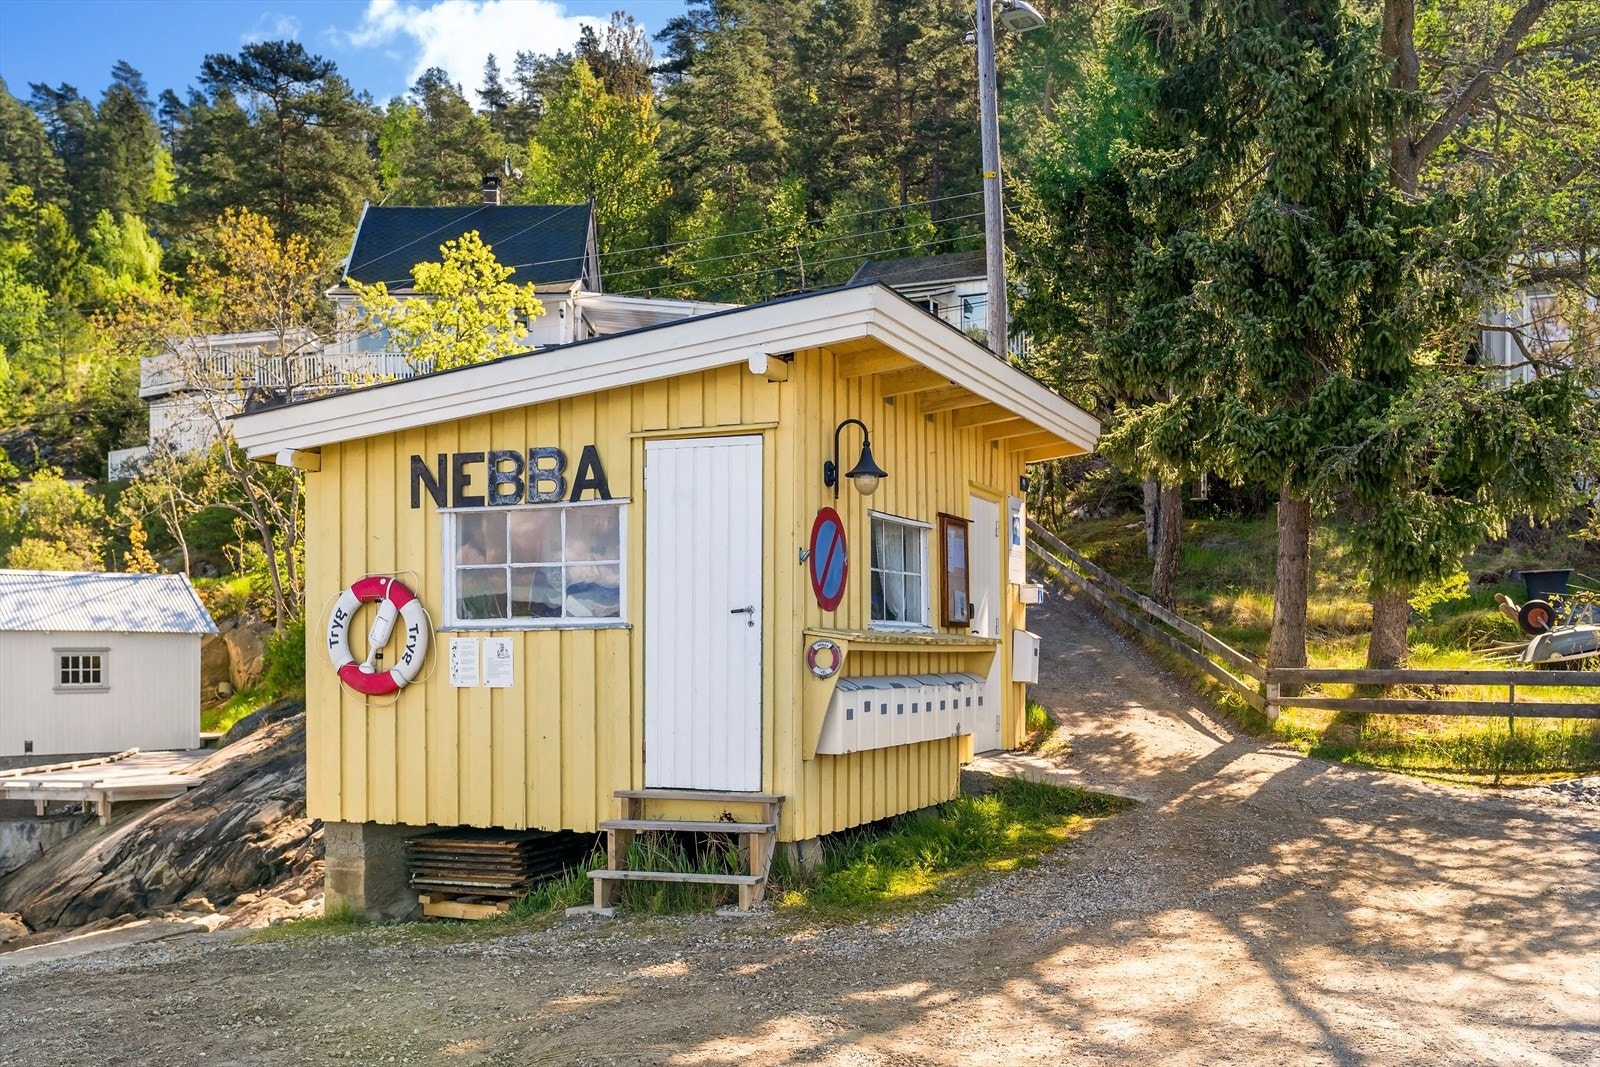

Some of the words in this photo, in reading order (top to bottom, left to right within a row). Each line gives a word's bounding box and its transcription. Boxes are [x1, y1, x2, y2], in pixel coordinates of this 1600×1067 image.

[410, 445, 612, 509] NEBBA
[328, 607, 348, 649] Tryg
[402, 623, 419, 666] Tryg
